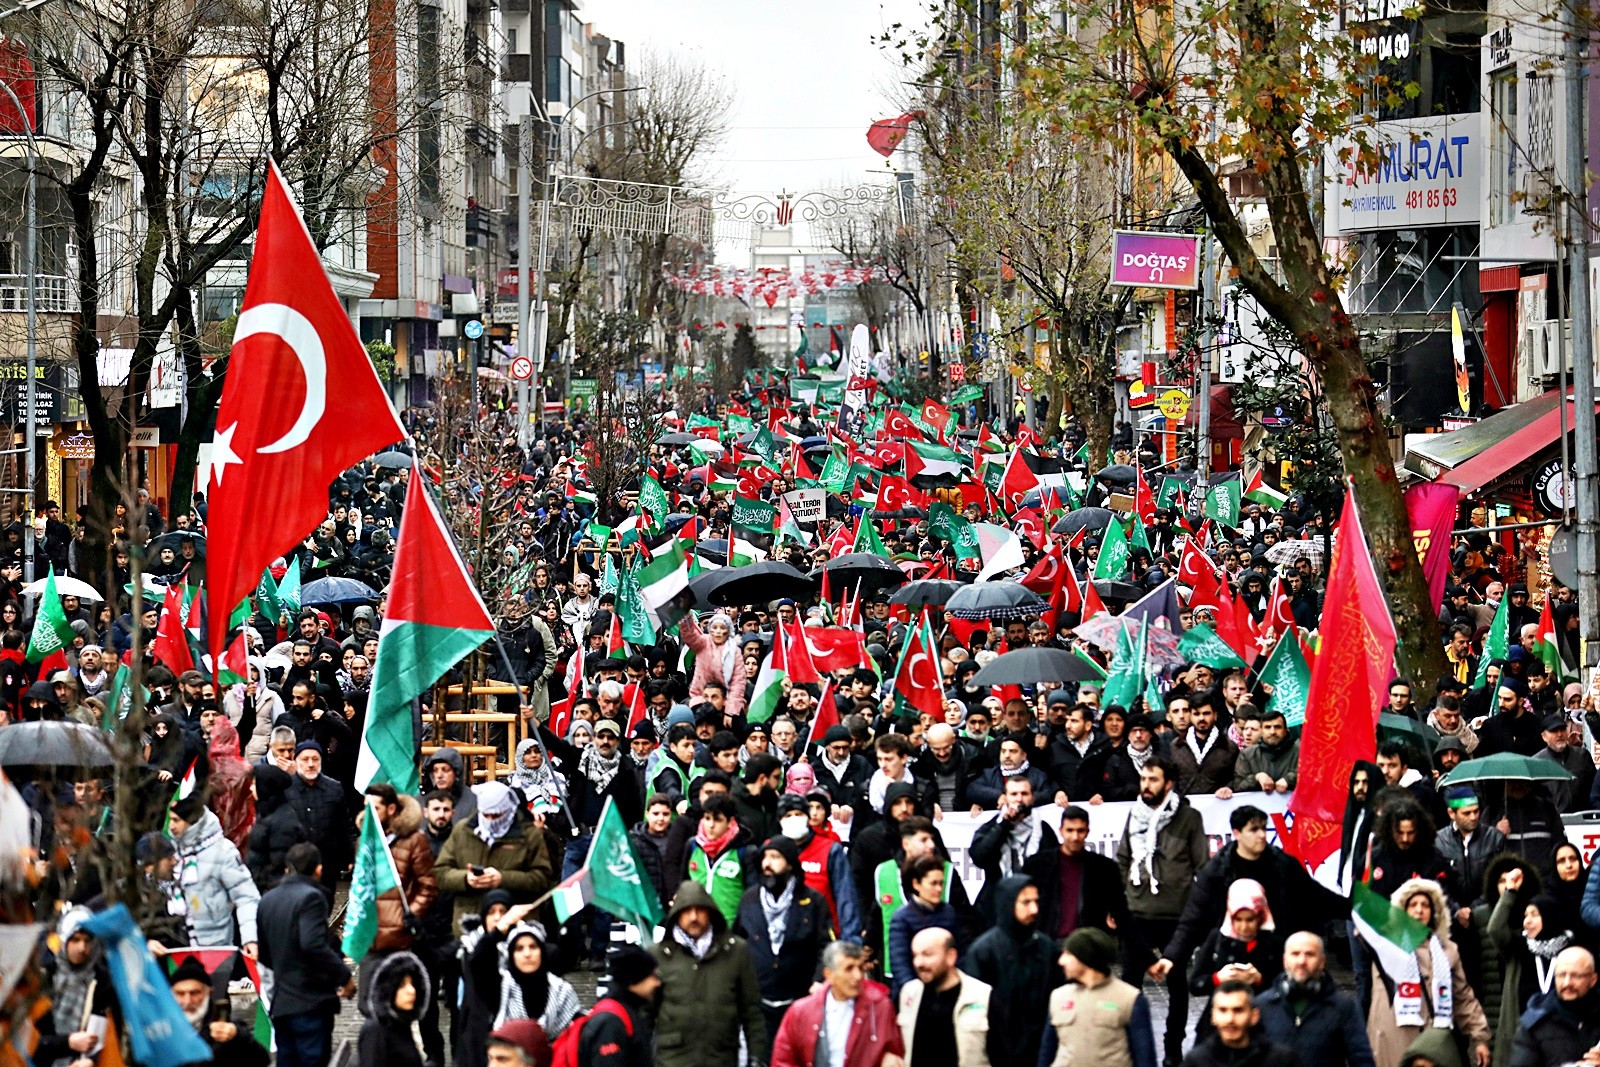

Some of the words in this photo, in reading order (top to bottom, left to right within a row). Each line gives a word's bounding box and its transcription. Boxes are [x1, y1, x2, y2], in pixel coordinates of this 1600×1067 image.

[1394, 32, 1410, 60] 00
[1406, 190, 1423, 209] 481
[1426, 189, 1440, 208] 85
[1442, 187, 1457, 207] 63
[1122, 252, 1187, 272] DOĞTAŞ
[0, 362, 45, 380] TİŞM
[18, 392, 52, 400] ELTİRİK
